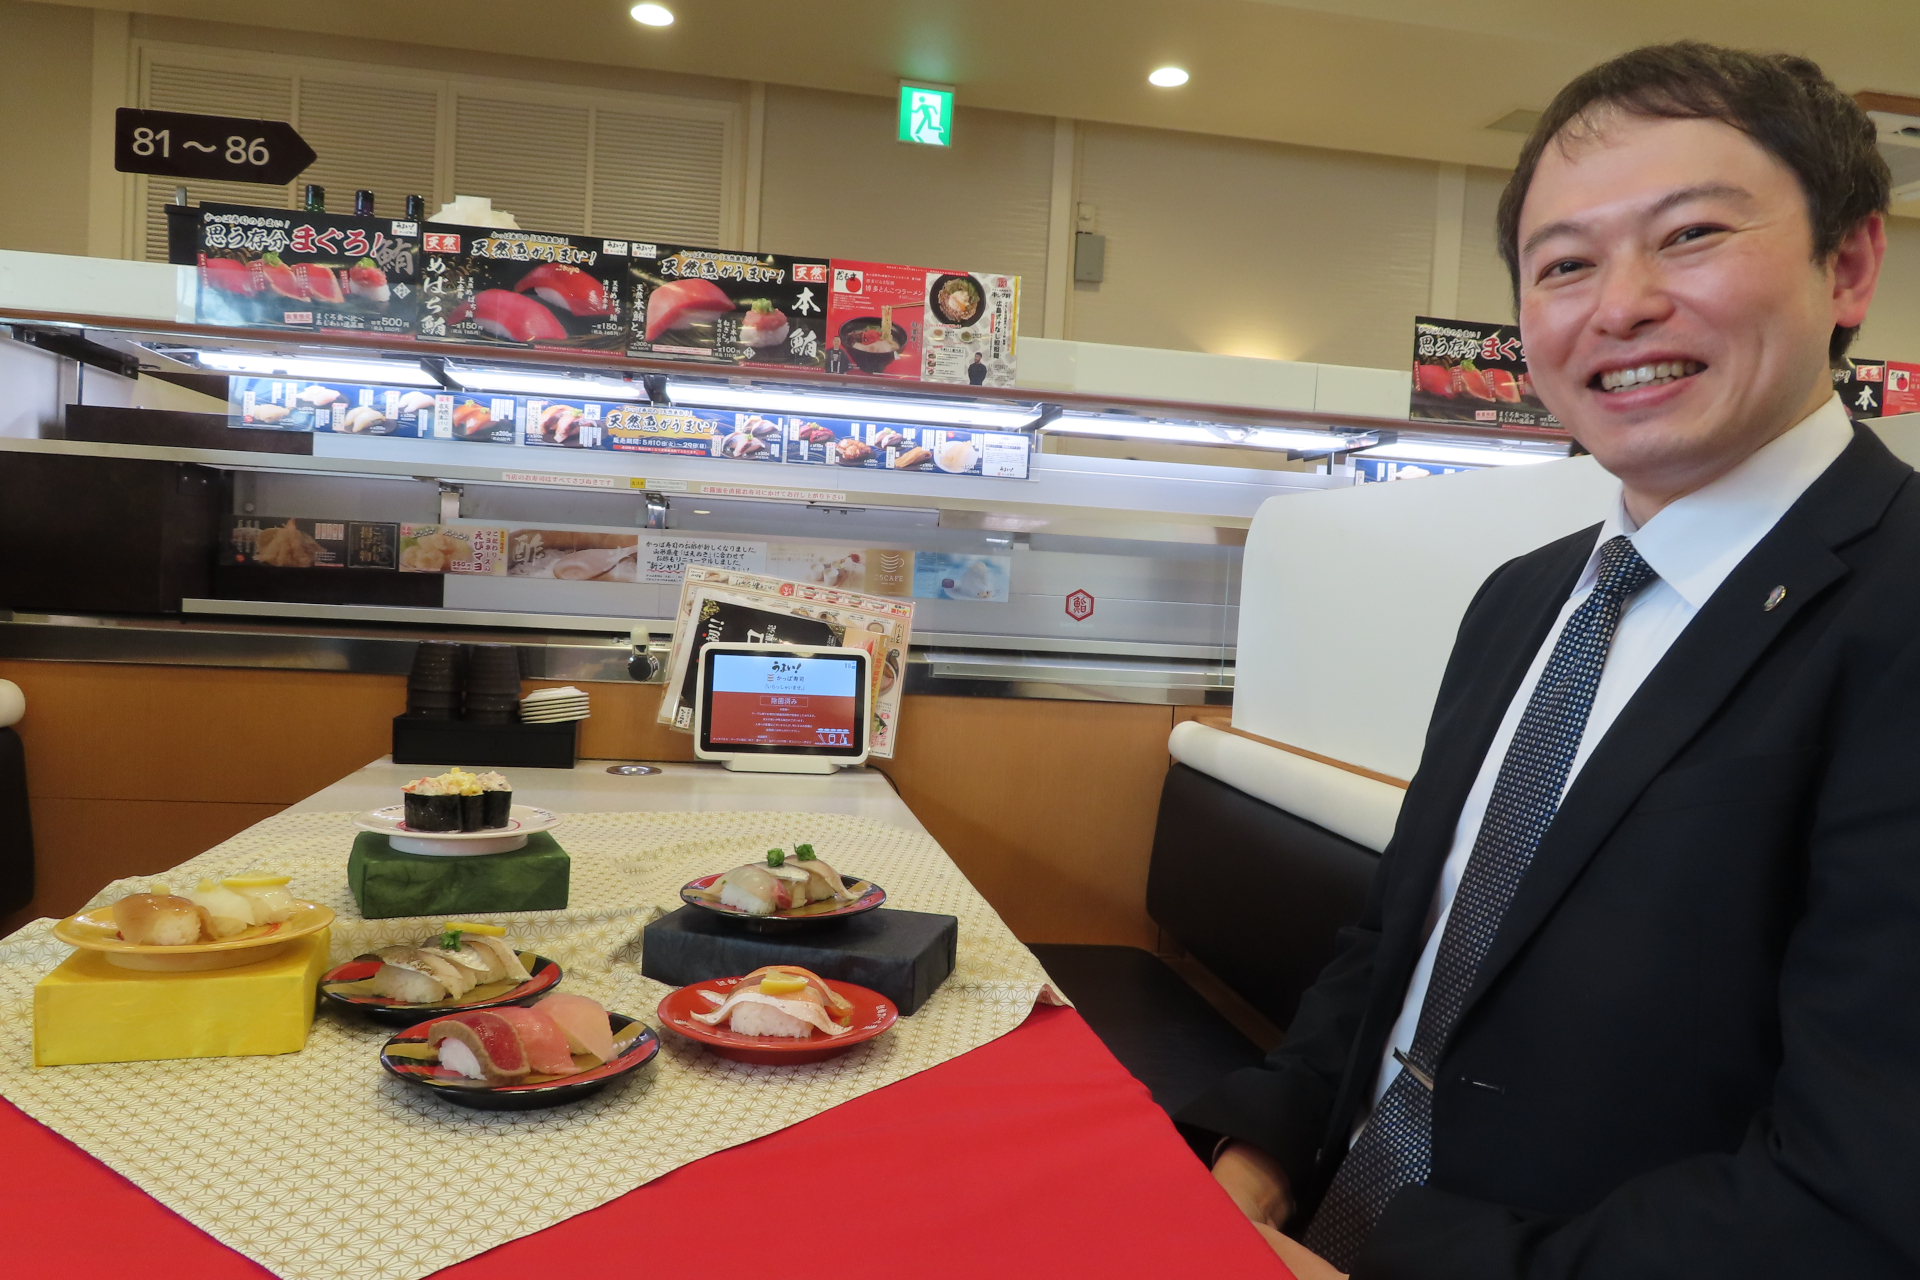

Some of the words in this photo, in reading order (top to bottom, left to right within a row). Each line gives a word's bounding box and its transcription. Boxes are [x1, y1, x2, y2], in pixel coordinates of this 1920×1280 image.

[426, 236, 456, 250] 天然
[795, 266, 823, 281] 天然
[420, 257, 447, 337] めばち鮪
[788, 287, 821, 358] 本鮪
[1854, 384, 1879, 411] 本
[771, 661, 802, 674] うまい!
[776, 675, 805, 683] かっぱ寿司
[770, 696, 798, 705] 除菌済み
